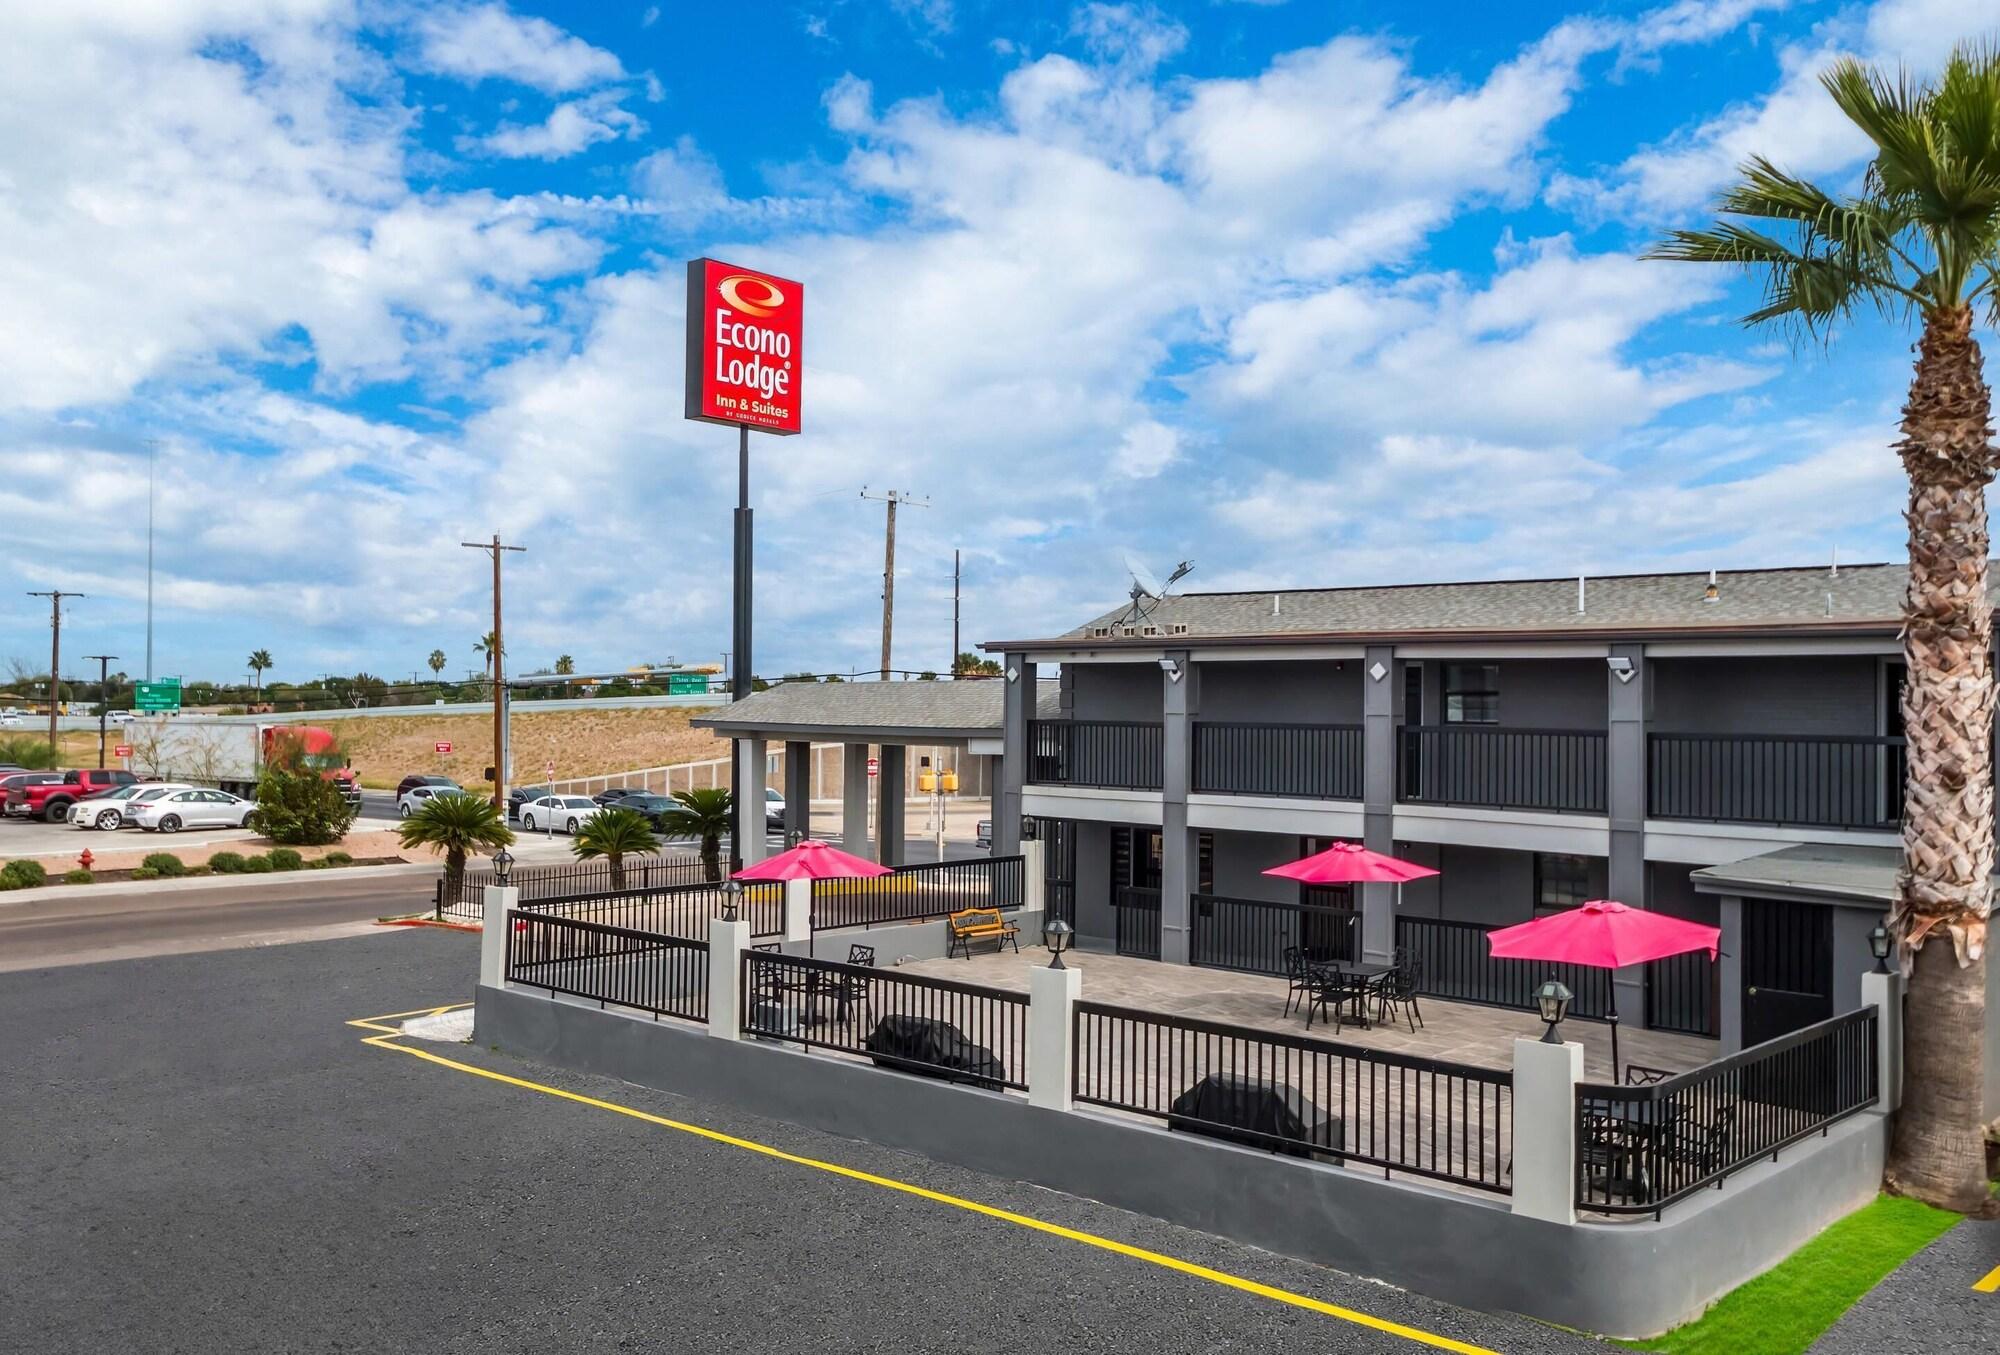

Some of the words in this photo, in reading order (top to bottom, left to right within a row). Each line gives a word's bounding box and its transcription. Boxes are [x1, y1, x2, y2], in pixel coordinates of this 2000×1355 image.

[716, 308, 791, 359] Econo
[716, 346, 789, 400] Lodge
[716, 394, 737, 409] Inn
[739, 398, 749, 411] &
[751, 400, 789, 419] Suites
